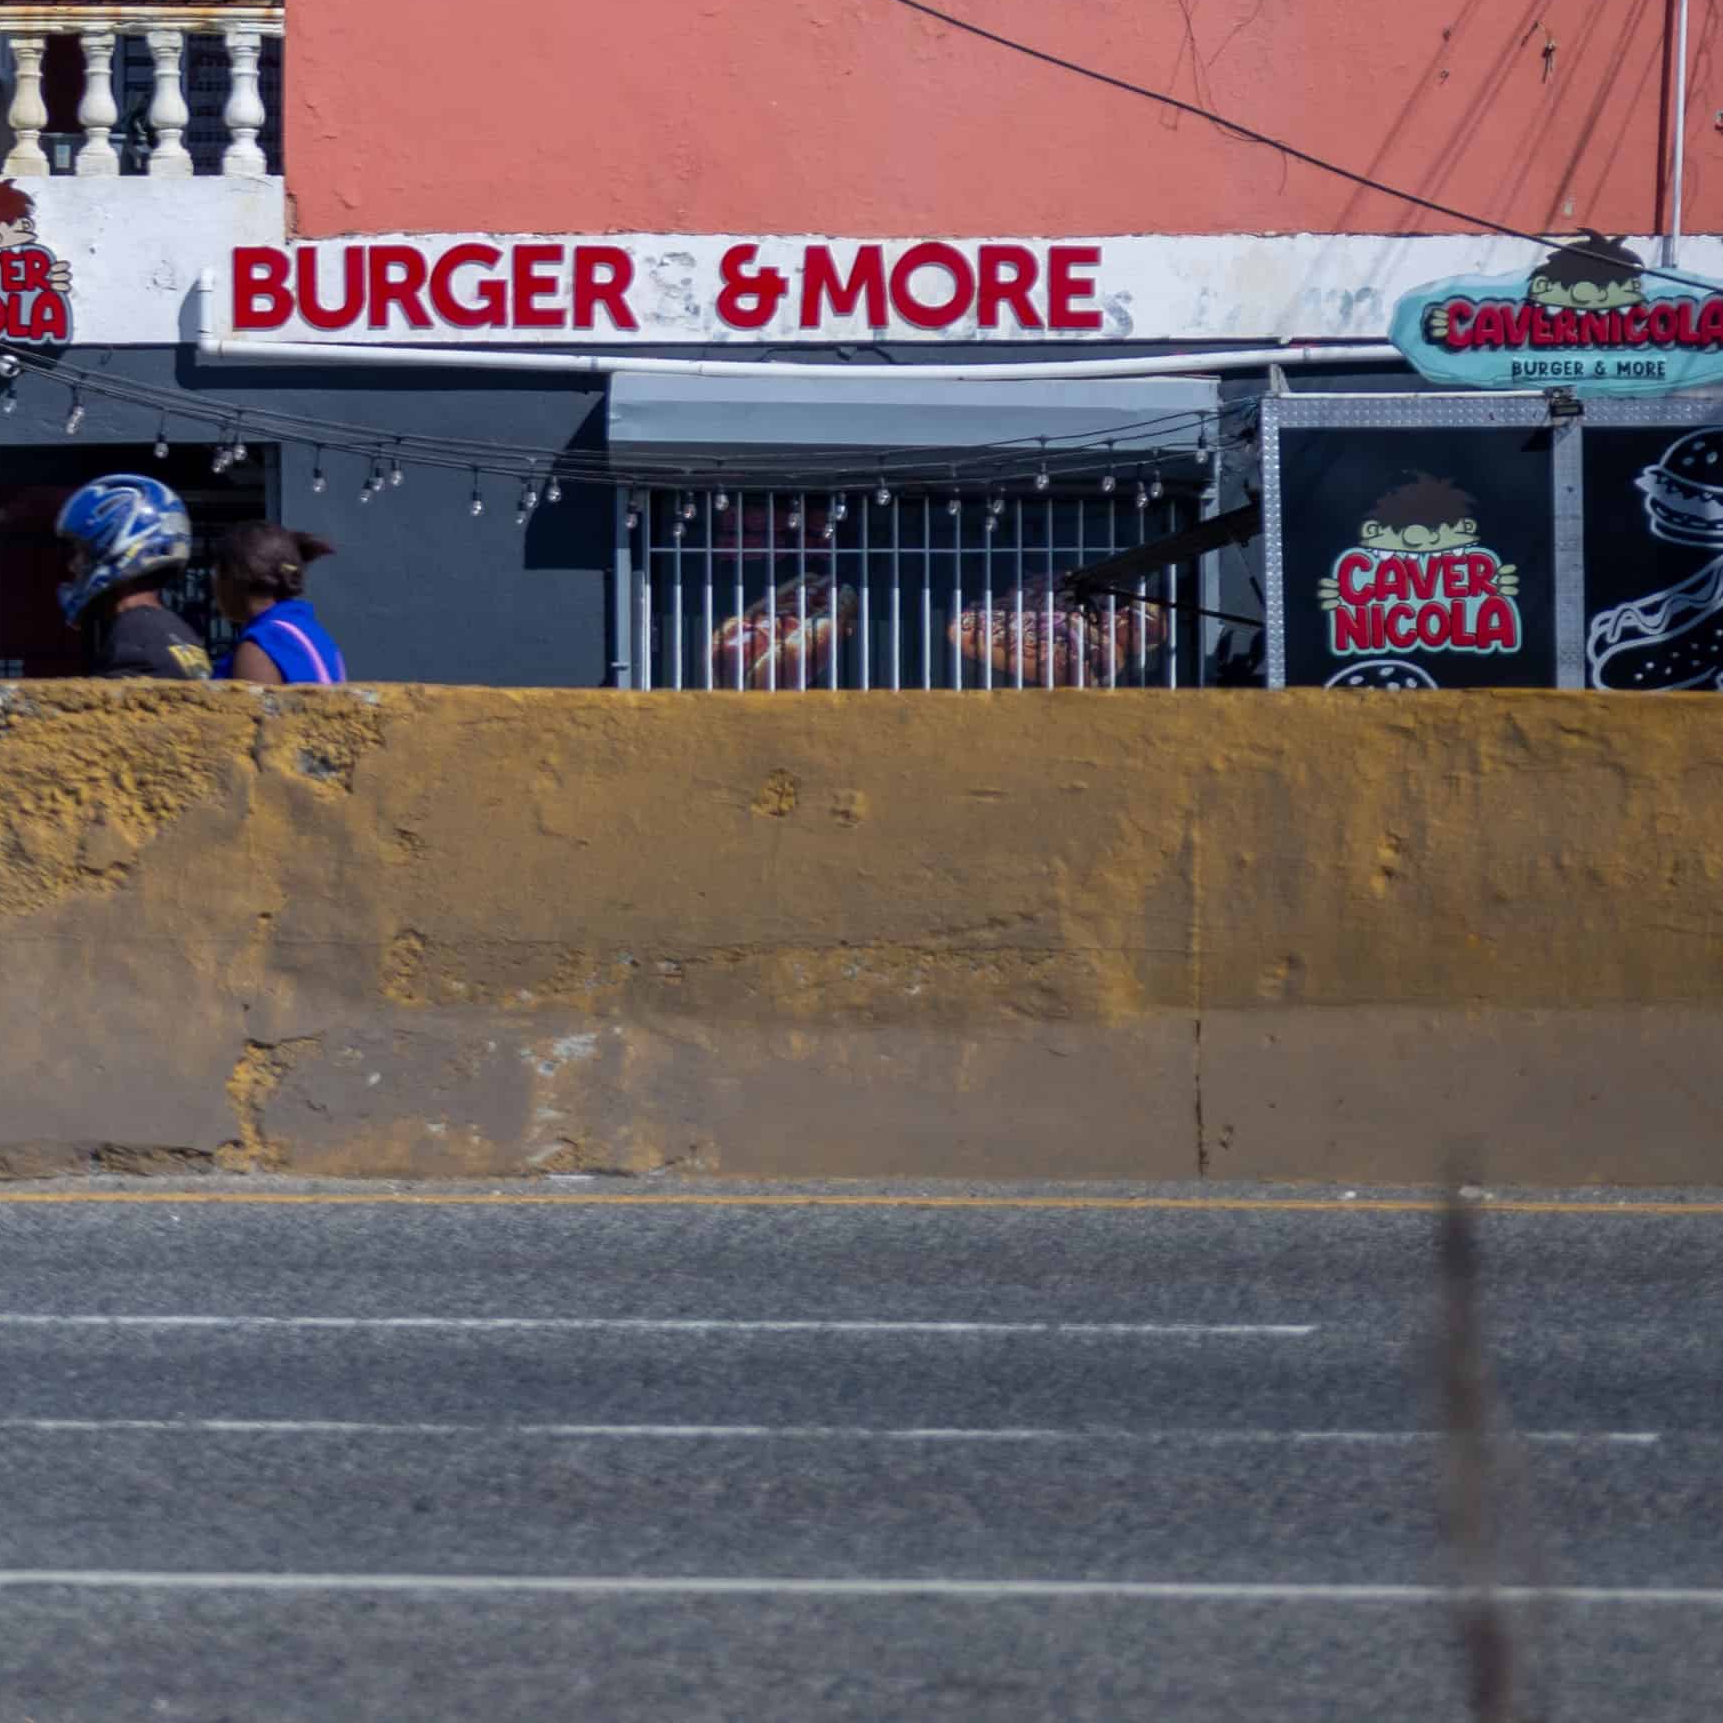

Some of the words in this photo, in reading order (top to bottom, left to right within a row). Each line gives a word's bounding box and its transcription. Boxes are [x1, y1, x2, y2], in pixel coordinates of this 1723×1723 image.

[233, 243, 639, 330] BURGER
[1445, 300, 1723, 347] CAVERNICOLA
[1512, 360, 1584, 377] BURGER
[1594, 361, 1605, 375] &
[1616, 361, 1666, 377] MORE
[1337, 553, 1501, 601] CAVER
[1335, 596, 1516, 650] NICOLA
